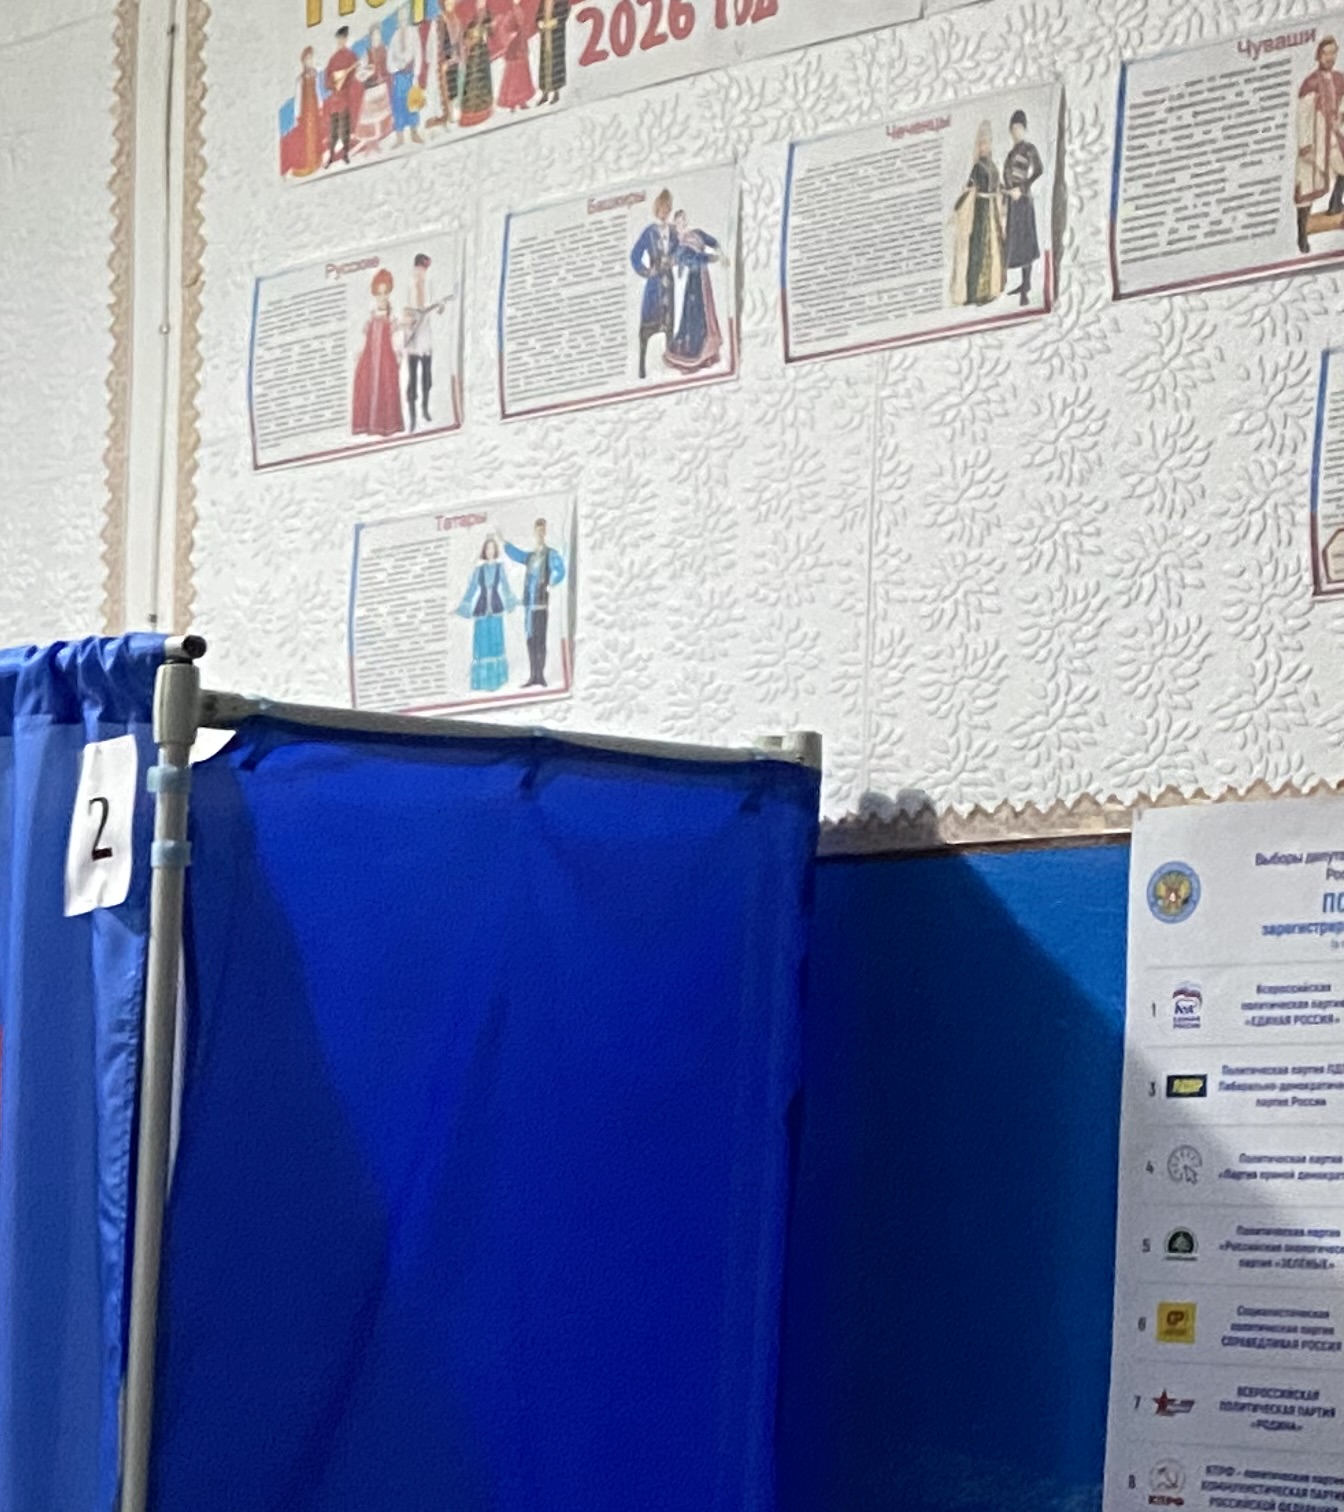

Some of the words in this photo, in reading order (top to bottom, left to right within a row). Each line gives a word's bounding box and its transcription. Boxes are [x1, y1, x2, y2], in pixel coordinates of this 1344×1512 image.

[576, 0, 695, 67] 2026
[1237, 28, 1316, 61] Чуваши
[885, 114, 952, 141] Чеченцы
[88, 796, 113, 862] 2
[1151, 1001, 1156, 1017] 1
[1142, 1237, 1151, 1252] 5
[1134, 1395, 1142, 1410] 7
